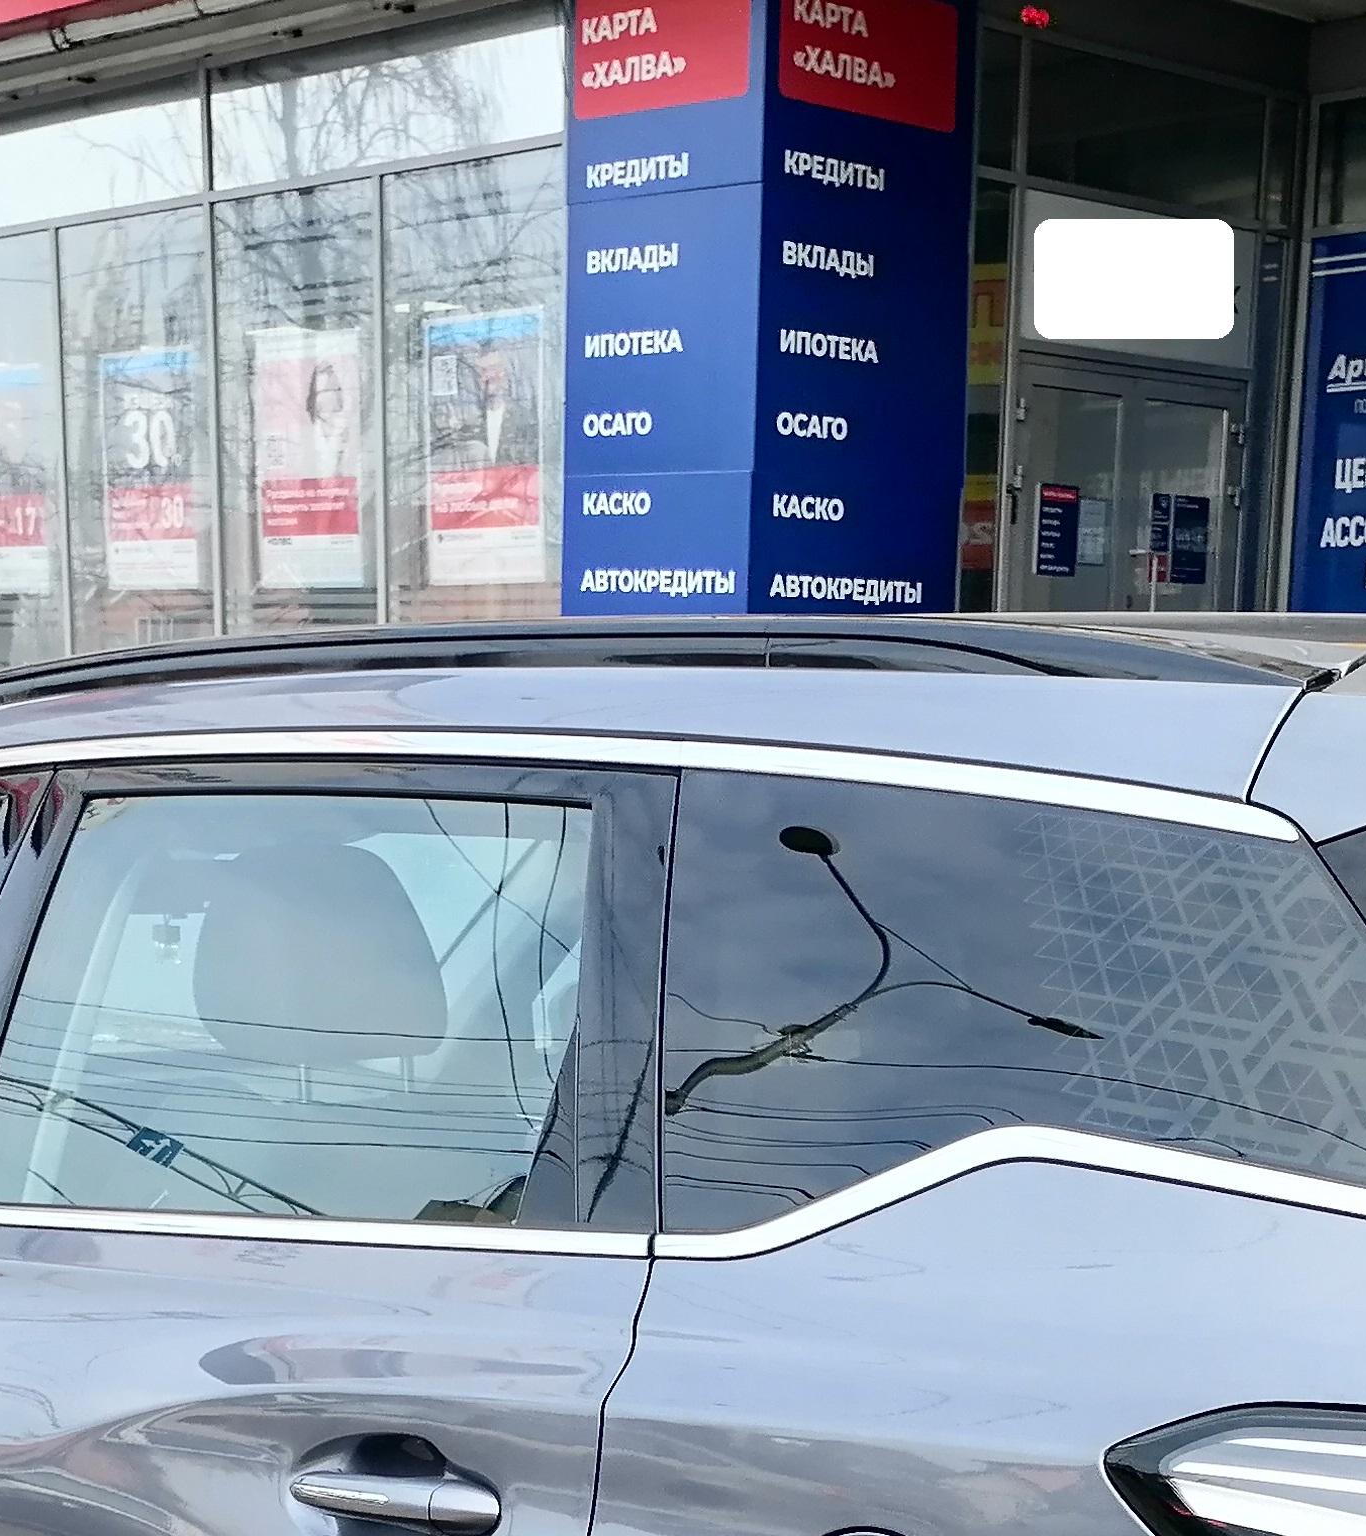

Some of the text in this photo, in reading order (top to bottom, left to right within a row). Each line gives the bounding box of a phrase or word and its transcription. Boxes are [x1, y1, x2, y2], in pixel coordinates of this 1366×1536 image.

[581, 7, 657, 46] КАРТА
[793, 0, 869, 38] КАРТА
[581, 51, 687, 90] «ХАЛВА»
[793, 45, 896, 89] «ХАЛВА»
[586, 152, 689, 189] КРЕДИТЫ
[784, 149, 885, 192] КРЕДИТЫ
[586, 242, 679, 274] ВКЛАДЫ
[782, 240, 874, 279] ВКЛАДЫ
[584, 328, 684, 358] ИПОТЕКА
[780, 328, 879, 364] ИПОТЕКА
[582, 411, 653, 437] ОСАГО
[776, 411, 848, 441] ОСАГО
[582, 490, 652, 516] КАСКО
[772, 493, 845, 521] КАСКО
[580, 568, 736, 598] АВТОКРЕДИТЫ
[769, 573, 922, 606] АВТОКРЕДИТЫ
